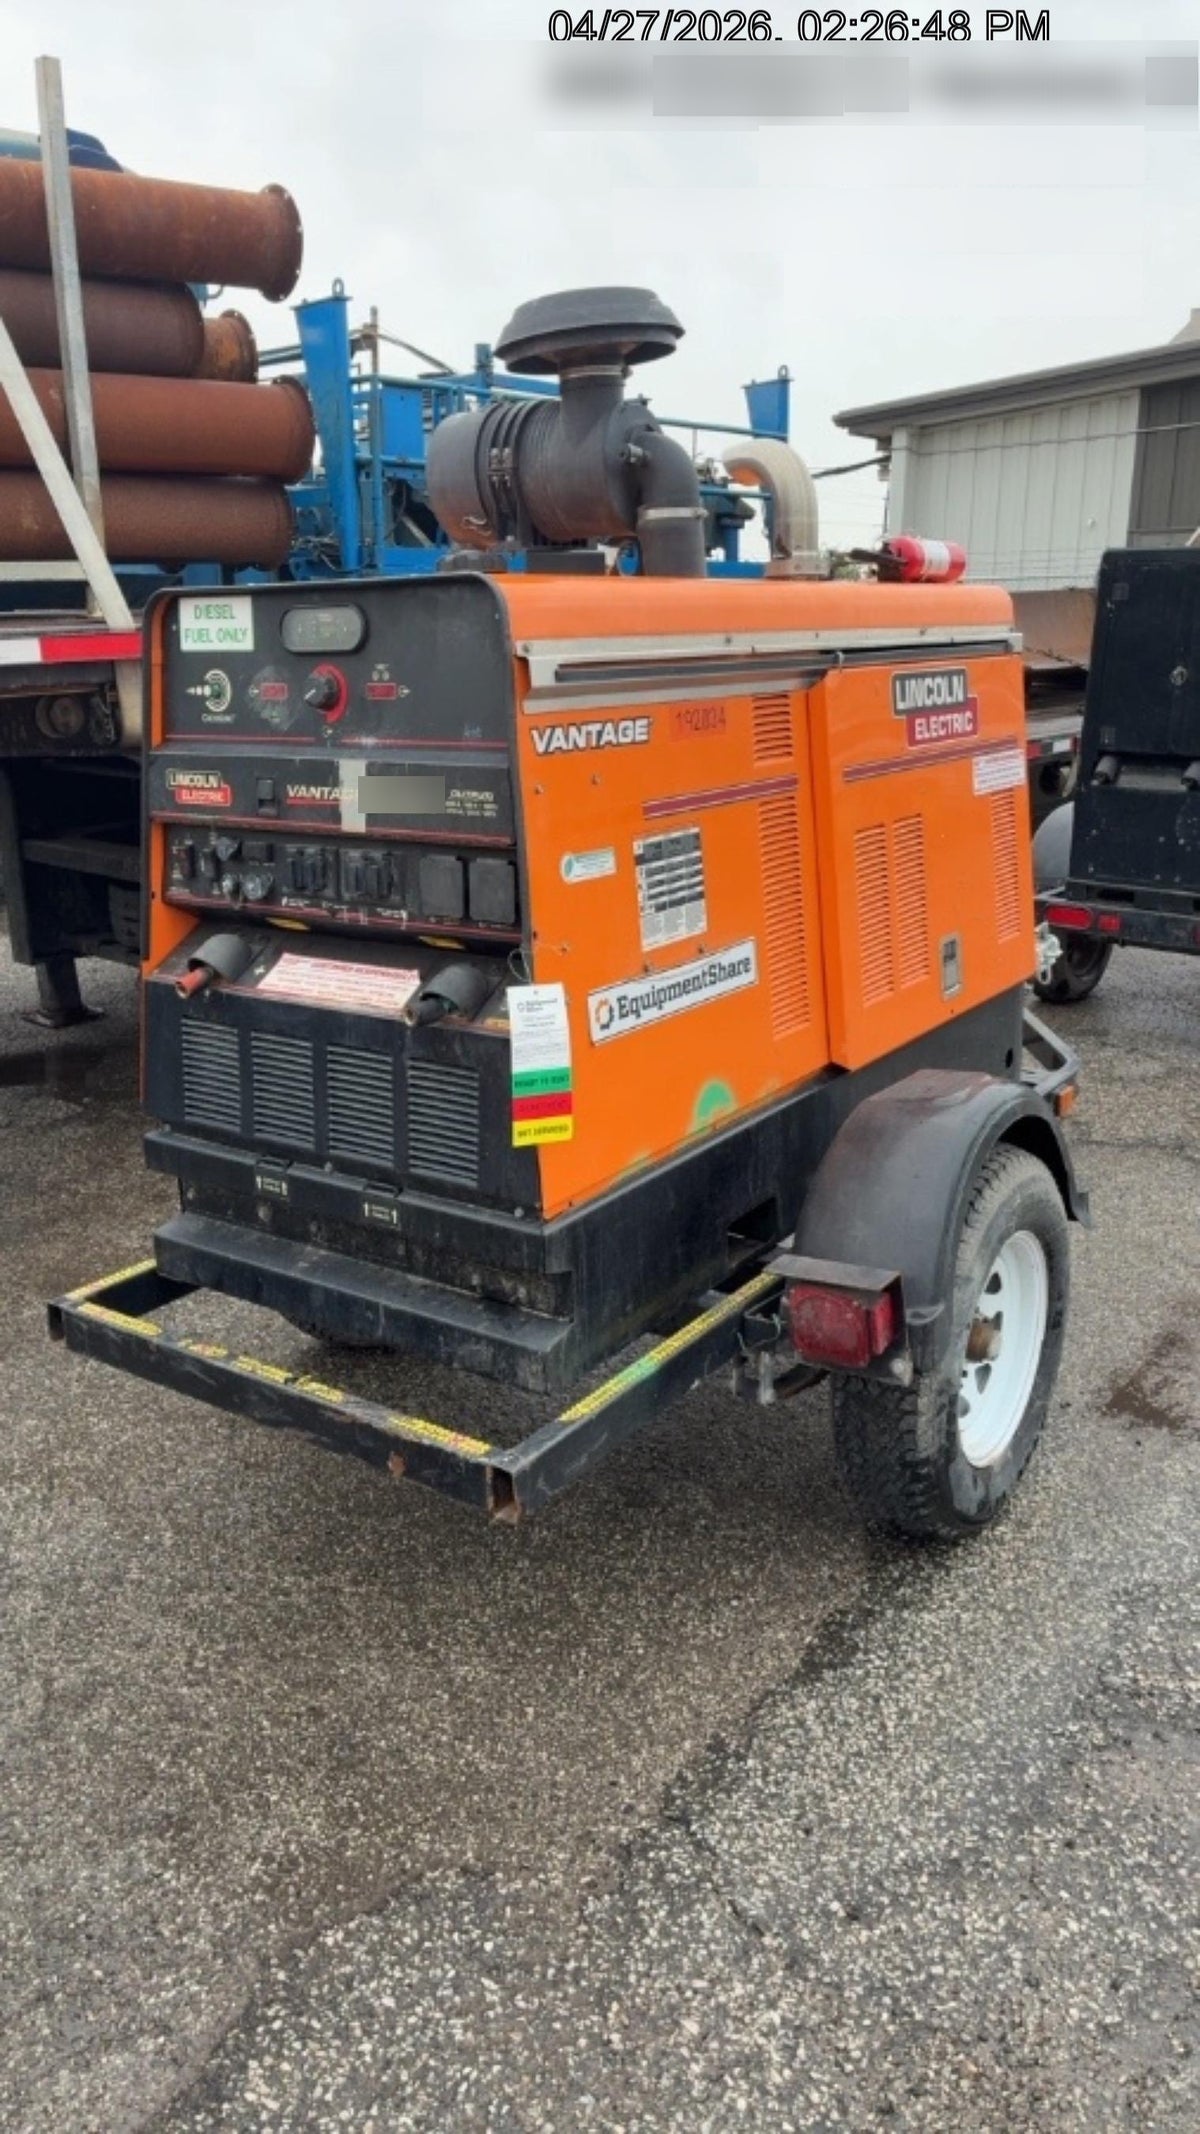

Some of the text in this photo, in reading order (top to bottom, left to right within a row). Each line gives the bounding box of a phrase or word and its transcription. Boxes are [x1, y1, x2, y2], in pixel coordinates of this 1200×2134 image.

[194, 604, 236, 619] DIESEL
[184, 627, 248, 643] FUEL ONLY
[895, 674, 965, 709] LINCOLN
[531, 718, 650, 754] VANTAGE
[914, 710, 974, 741] ELECTRIC
[170, 772, 219, 788] LINCOLN
[182, 788, 225, 802] ELECTRIC
[616, 955, 752, 1019] EquipmentShare
